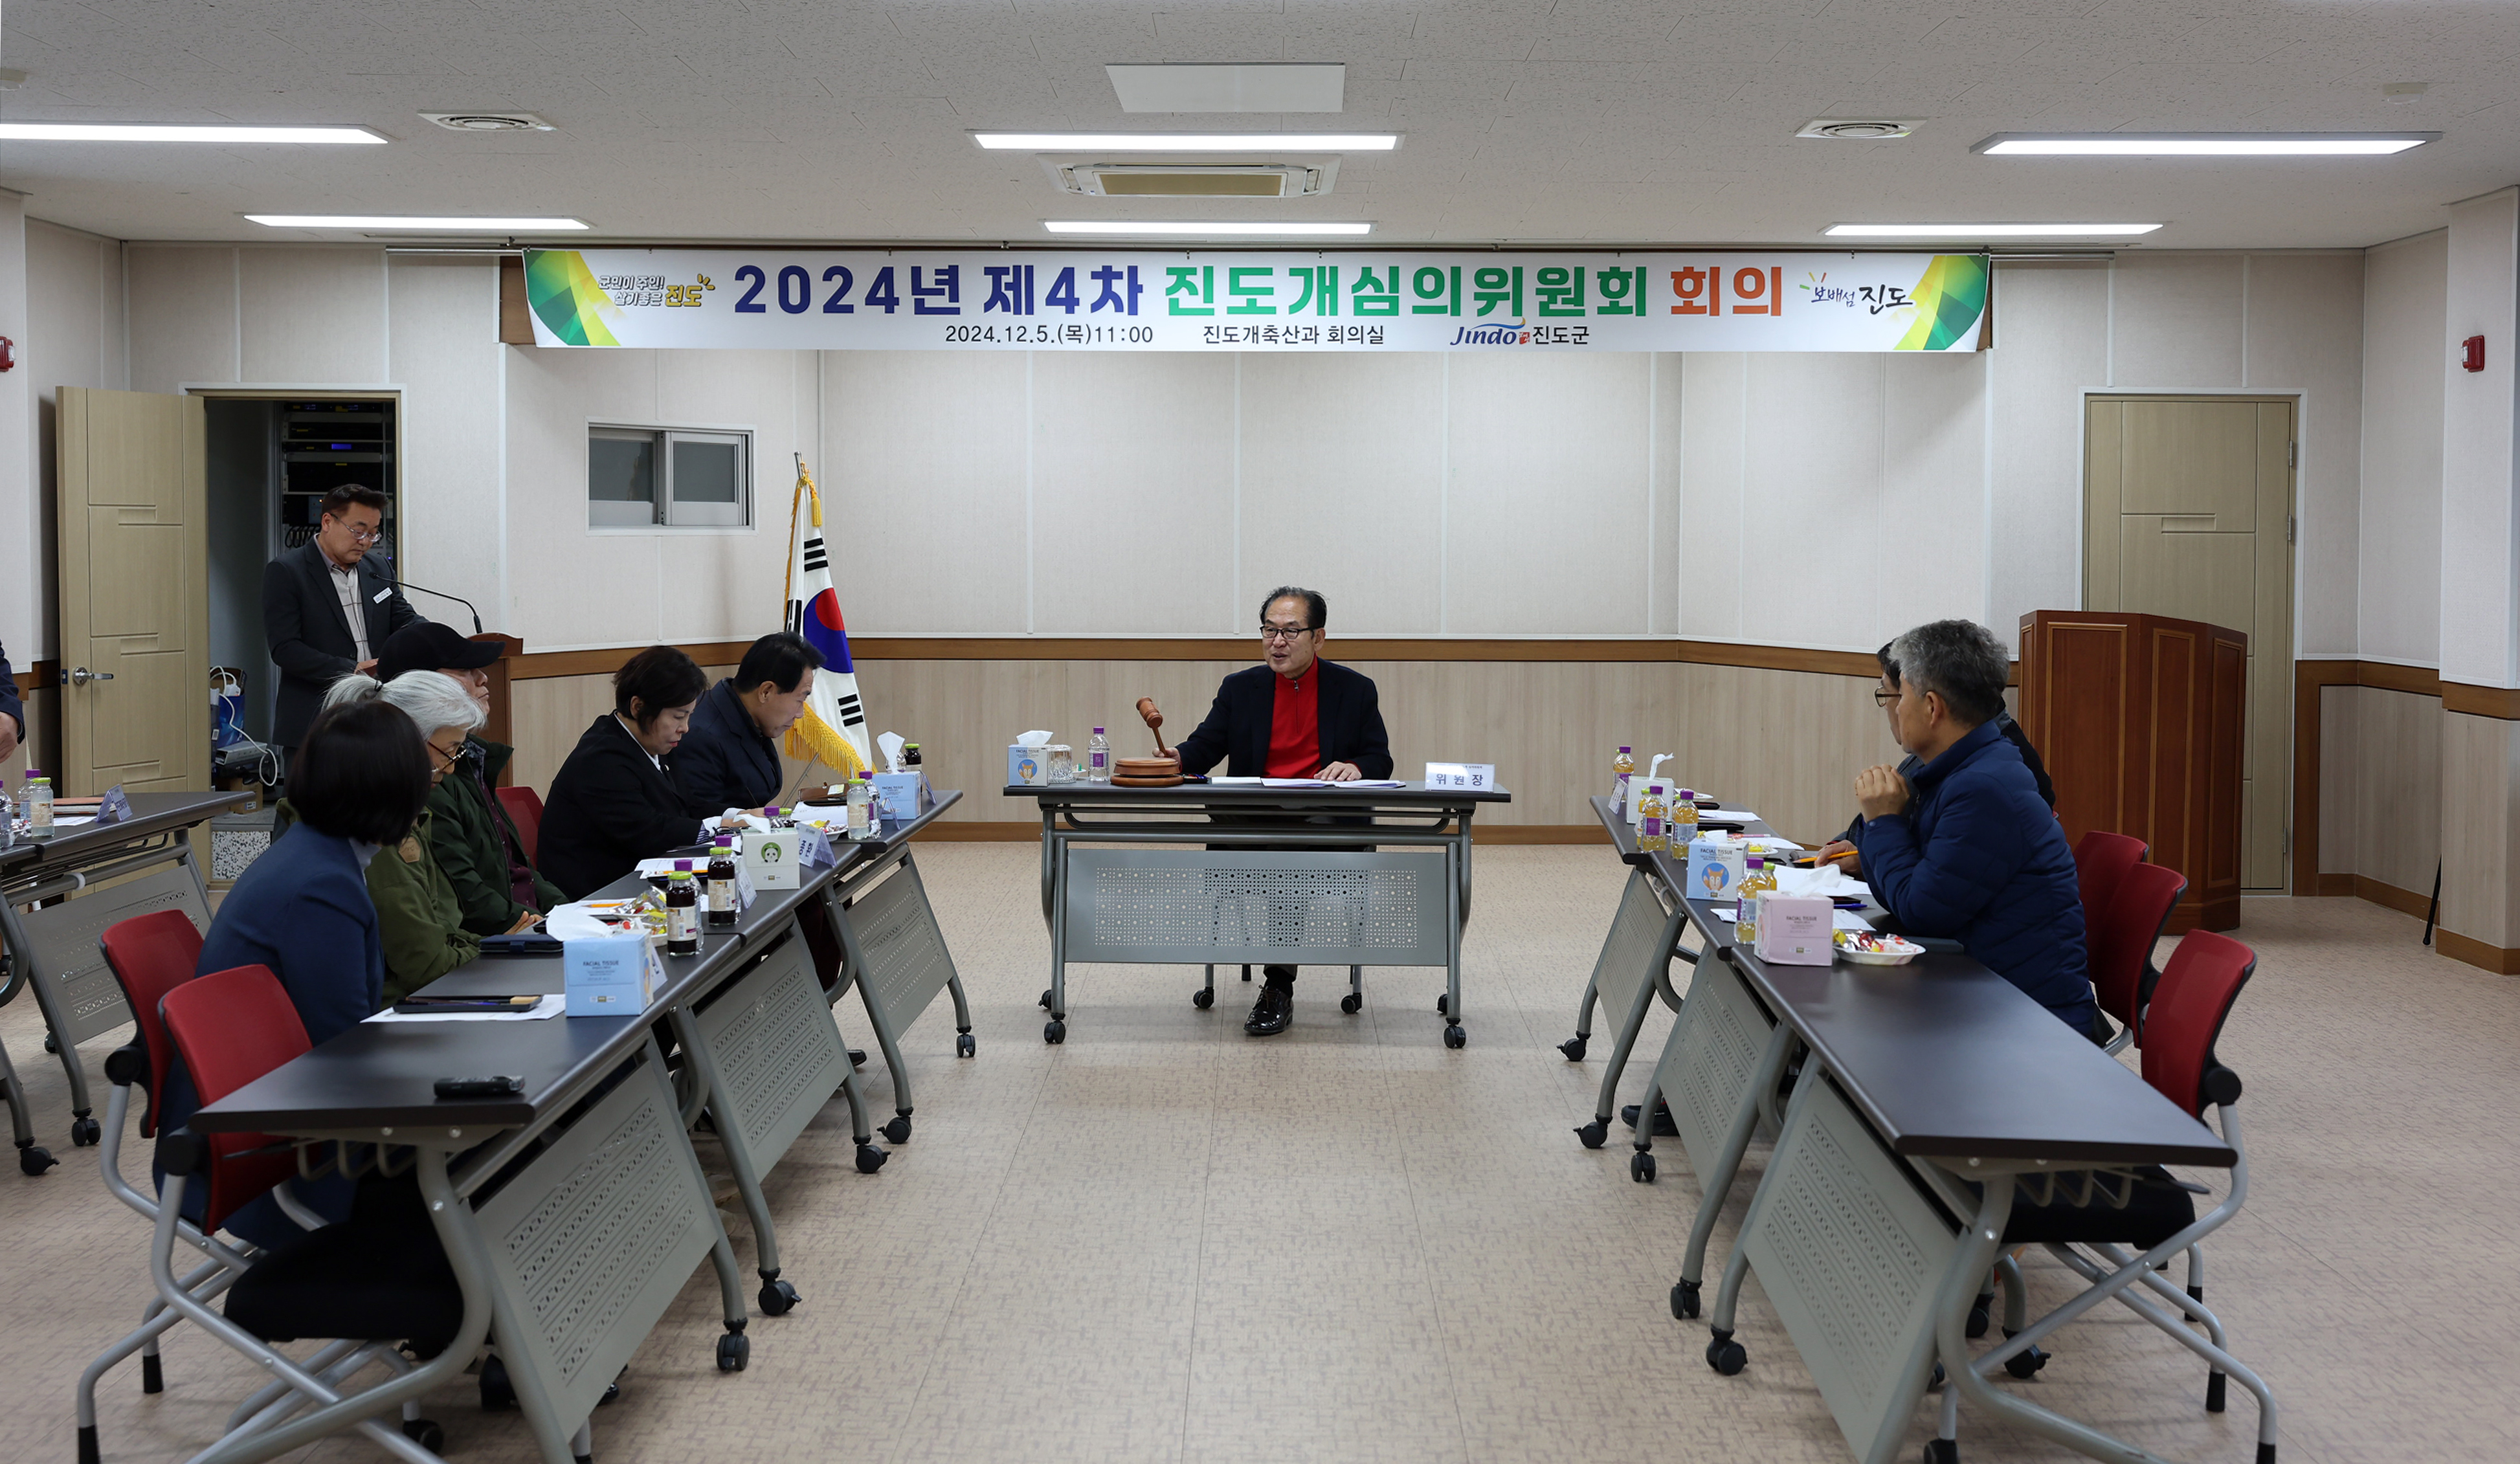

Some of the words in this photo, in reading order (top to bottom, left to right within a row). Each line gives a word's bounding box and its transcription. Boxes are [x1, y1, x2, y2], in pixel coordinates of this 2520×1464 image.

[598, 276, 634, 290] 군민이
[636, 276, 665, 290] 주인!
[735, 265, 961, 315] 2024년
[983, 264, 1143, 316] 제4차
[1166, 265, 1647, 317] 진도개심의위원회
[1670, 266, 1782, 316] 회의
[615, 291, 662, 306] 살기좋은
[665, 285, 702, 307] 진도
[1811, 286, 1855, 307] 보배섬
[1858, 283, 1913, 315] 진도
[1203, 325, 1320, 345] 진도개축산과
[1327, 325, 1384, 345] 회의실
[1449, 324, 1517, 346] Jindo
[1532, 325, 1590, 345] 진도군
